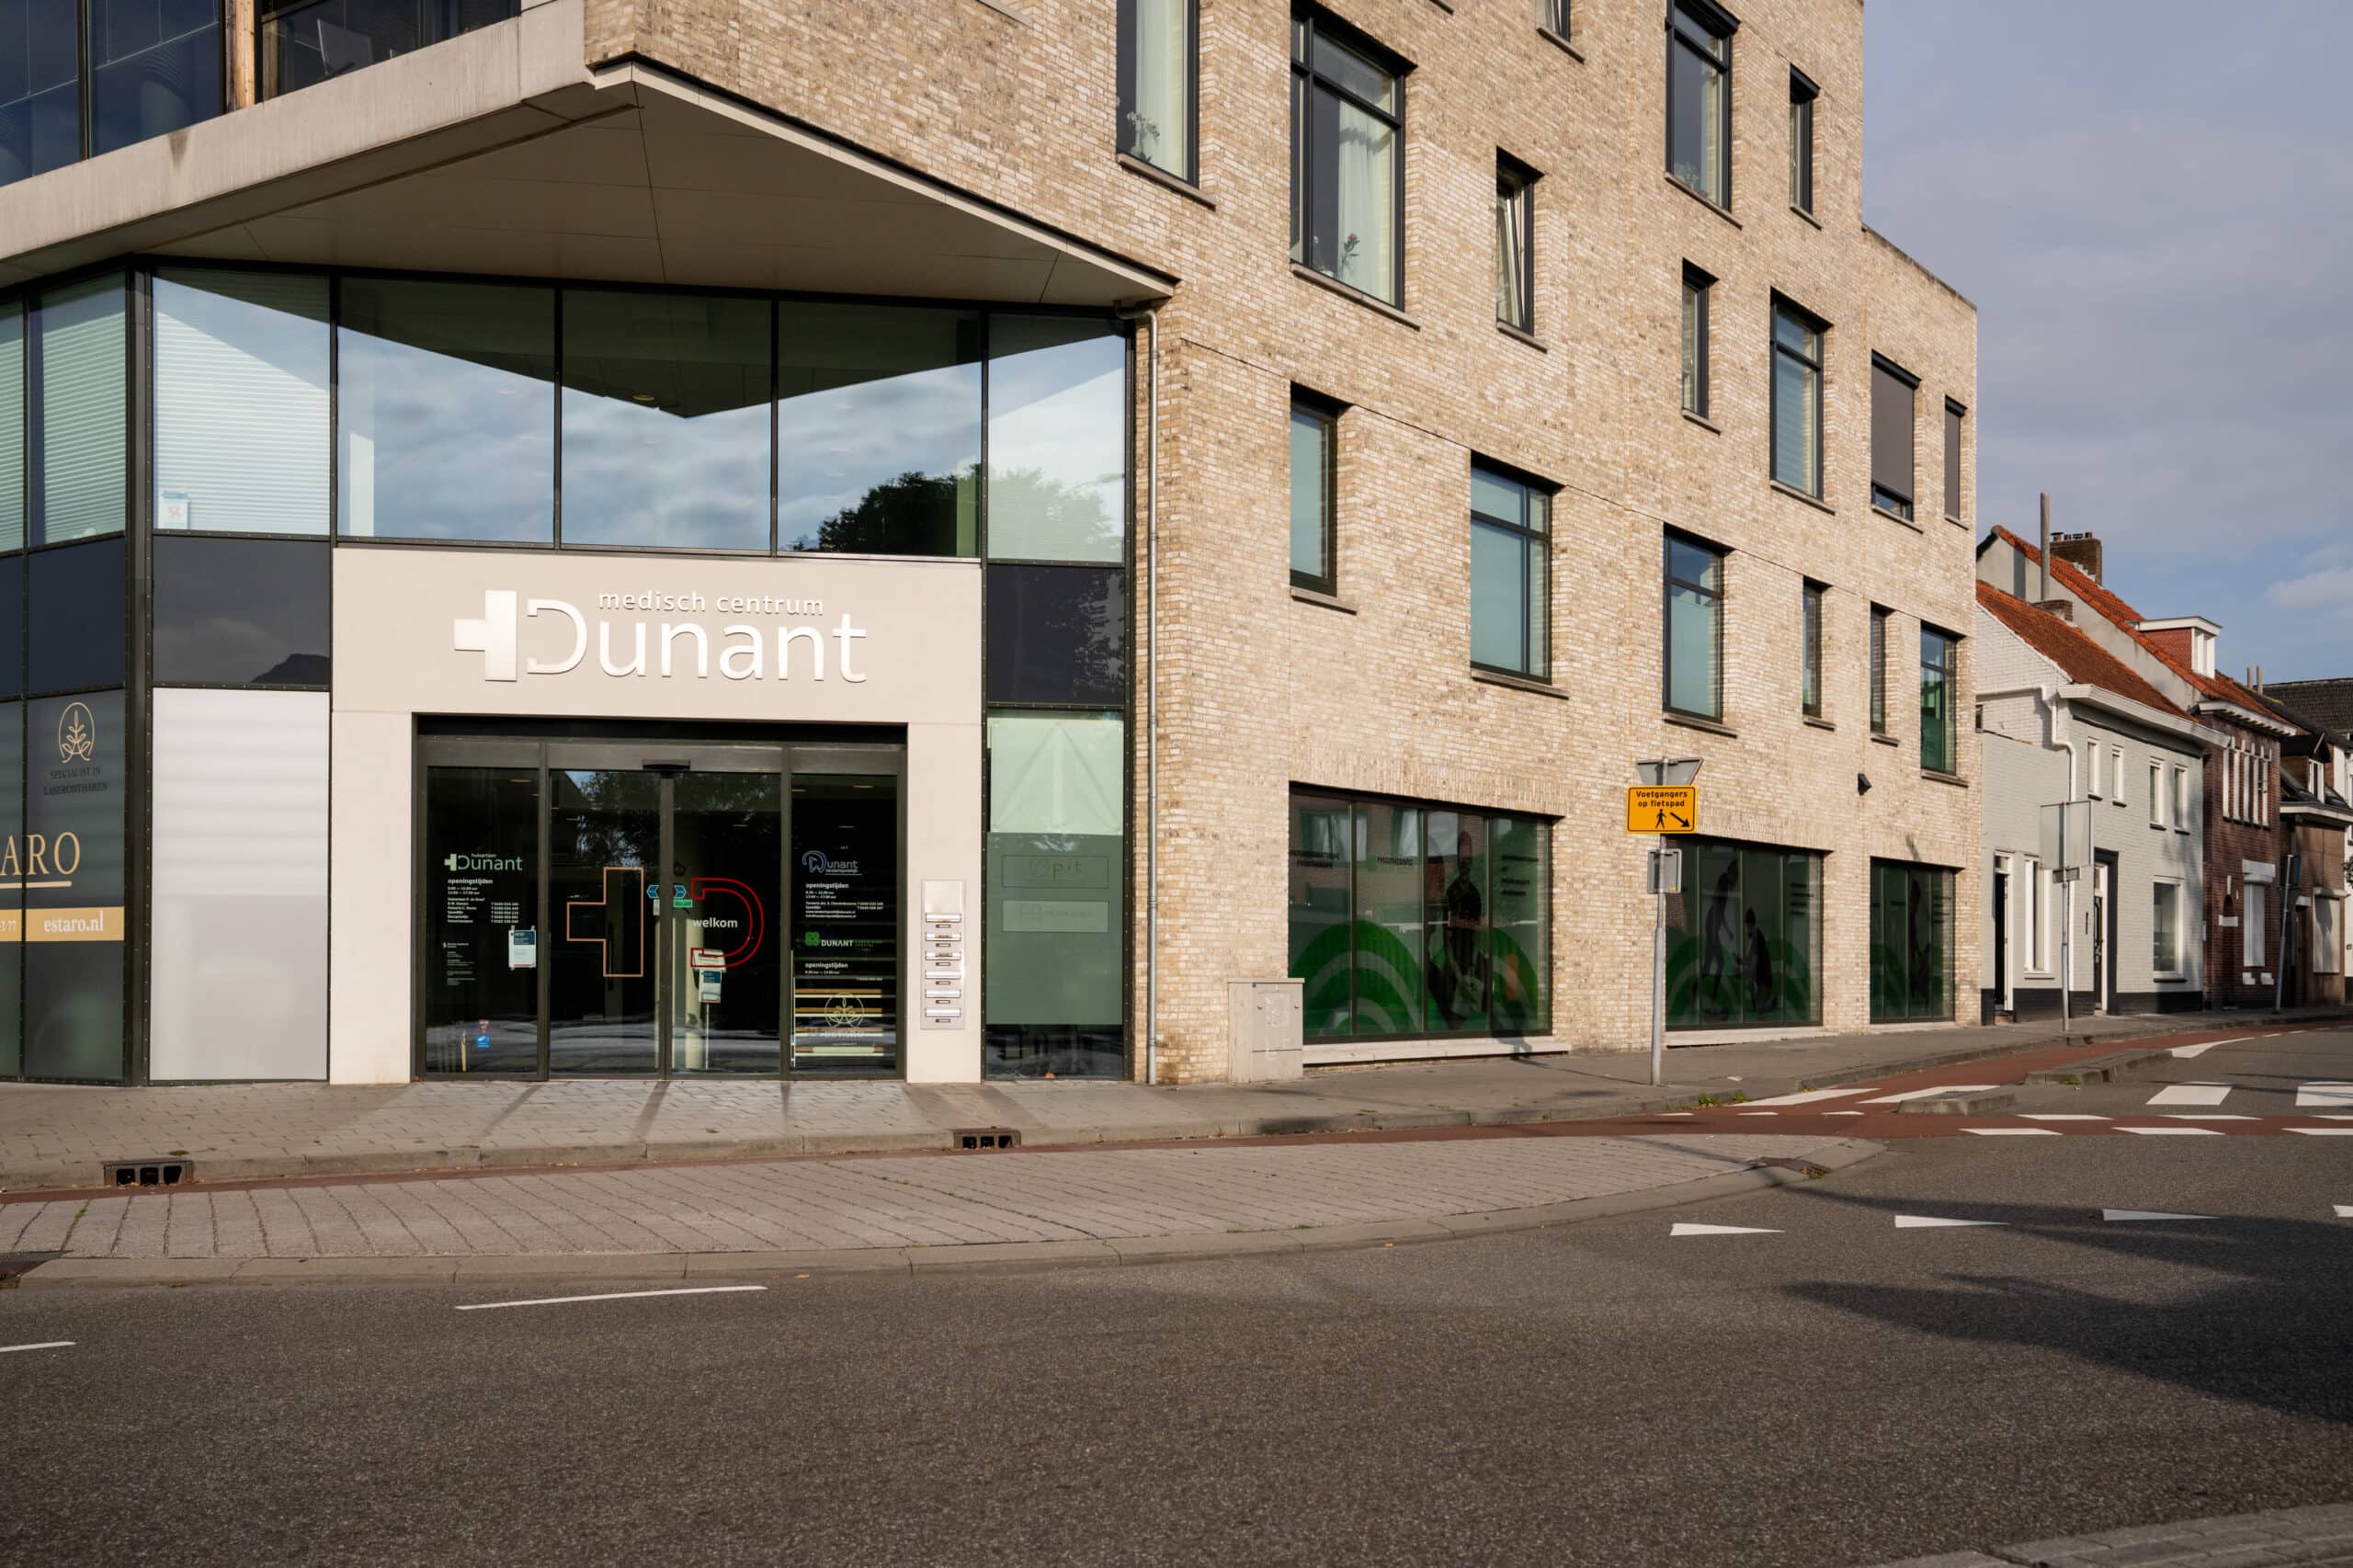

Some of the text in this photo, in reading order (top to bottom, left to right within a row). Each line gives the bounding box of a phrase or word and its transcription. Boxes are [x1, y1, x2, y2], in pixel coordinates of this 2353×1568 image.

[598, 590, 824, 615] medisch centrum
[527, 598, 868, 683] Dunant
[1636, 790, 1688, 799] Voetgangers
[1651, 800, 1685, 808] fietspad
[458, 854, 523, 871] Dunant
[43, 910, 104, 933] estaro.nl
[691, 917, 739, 927] welkom
[821, 939, 855, 948] DUNANT
